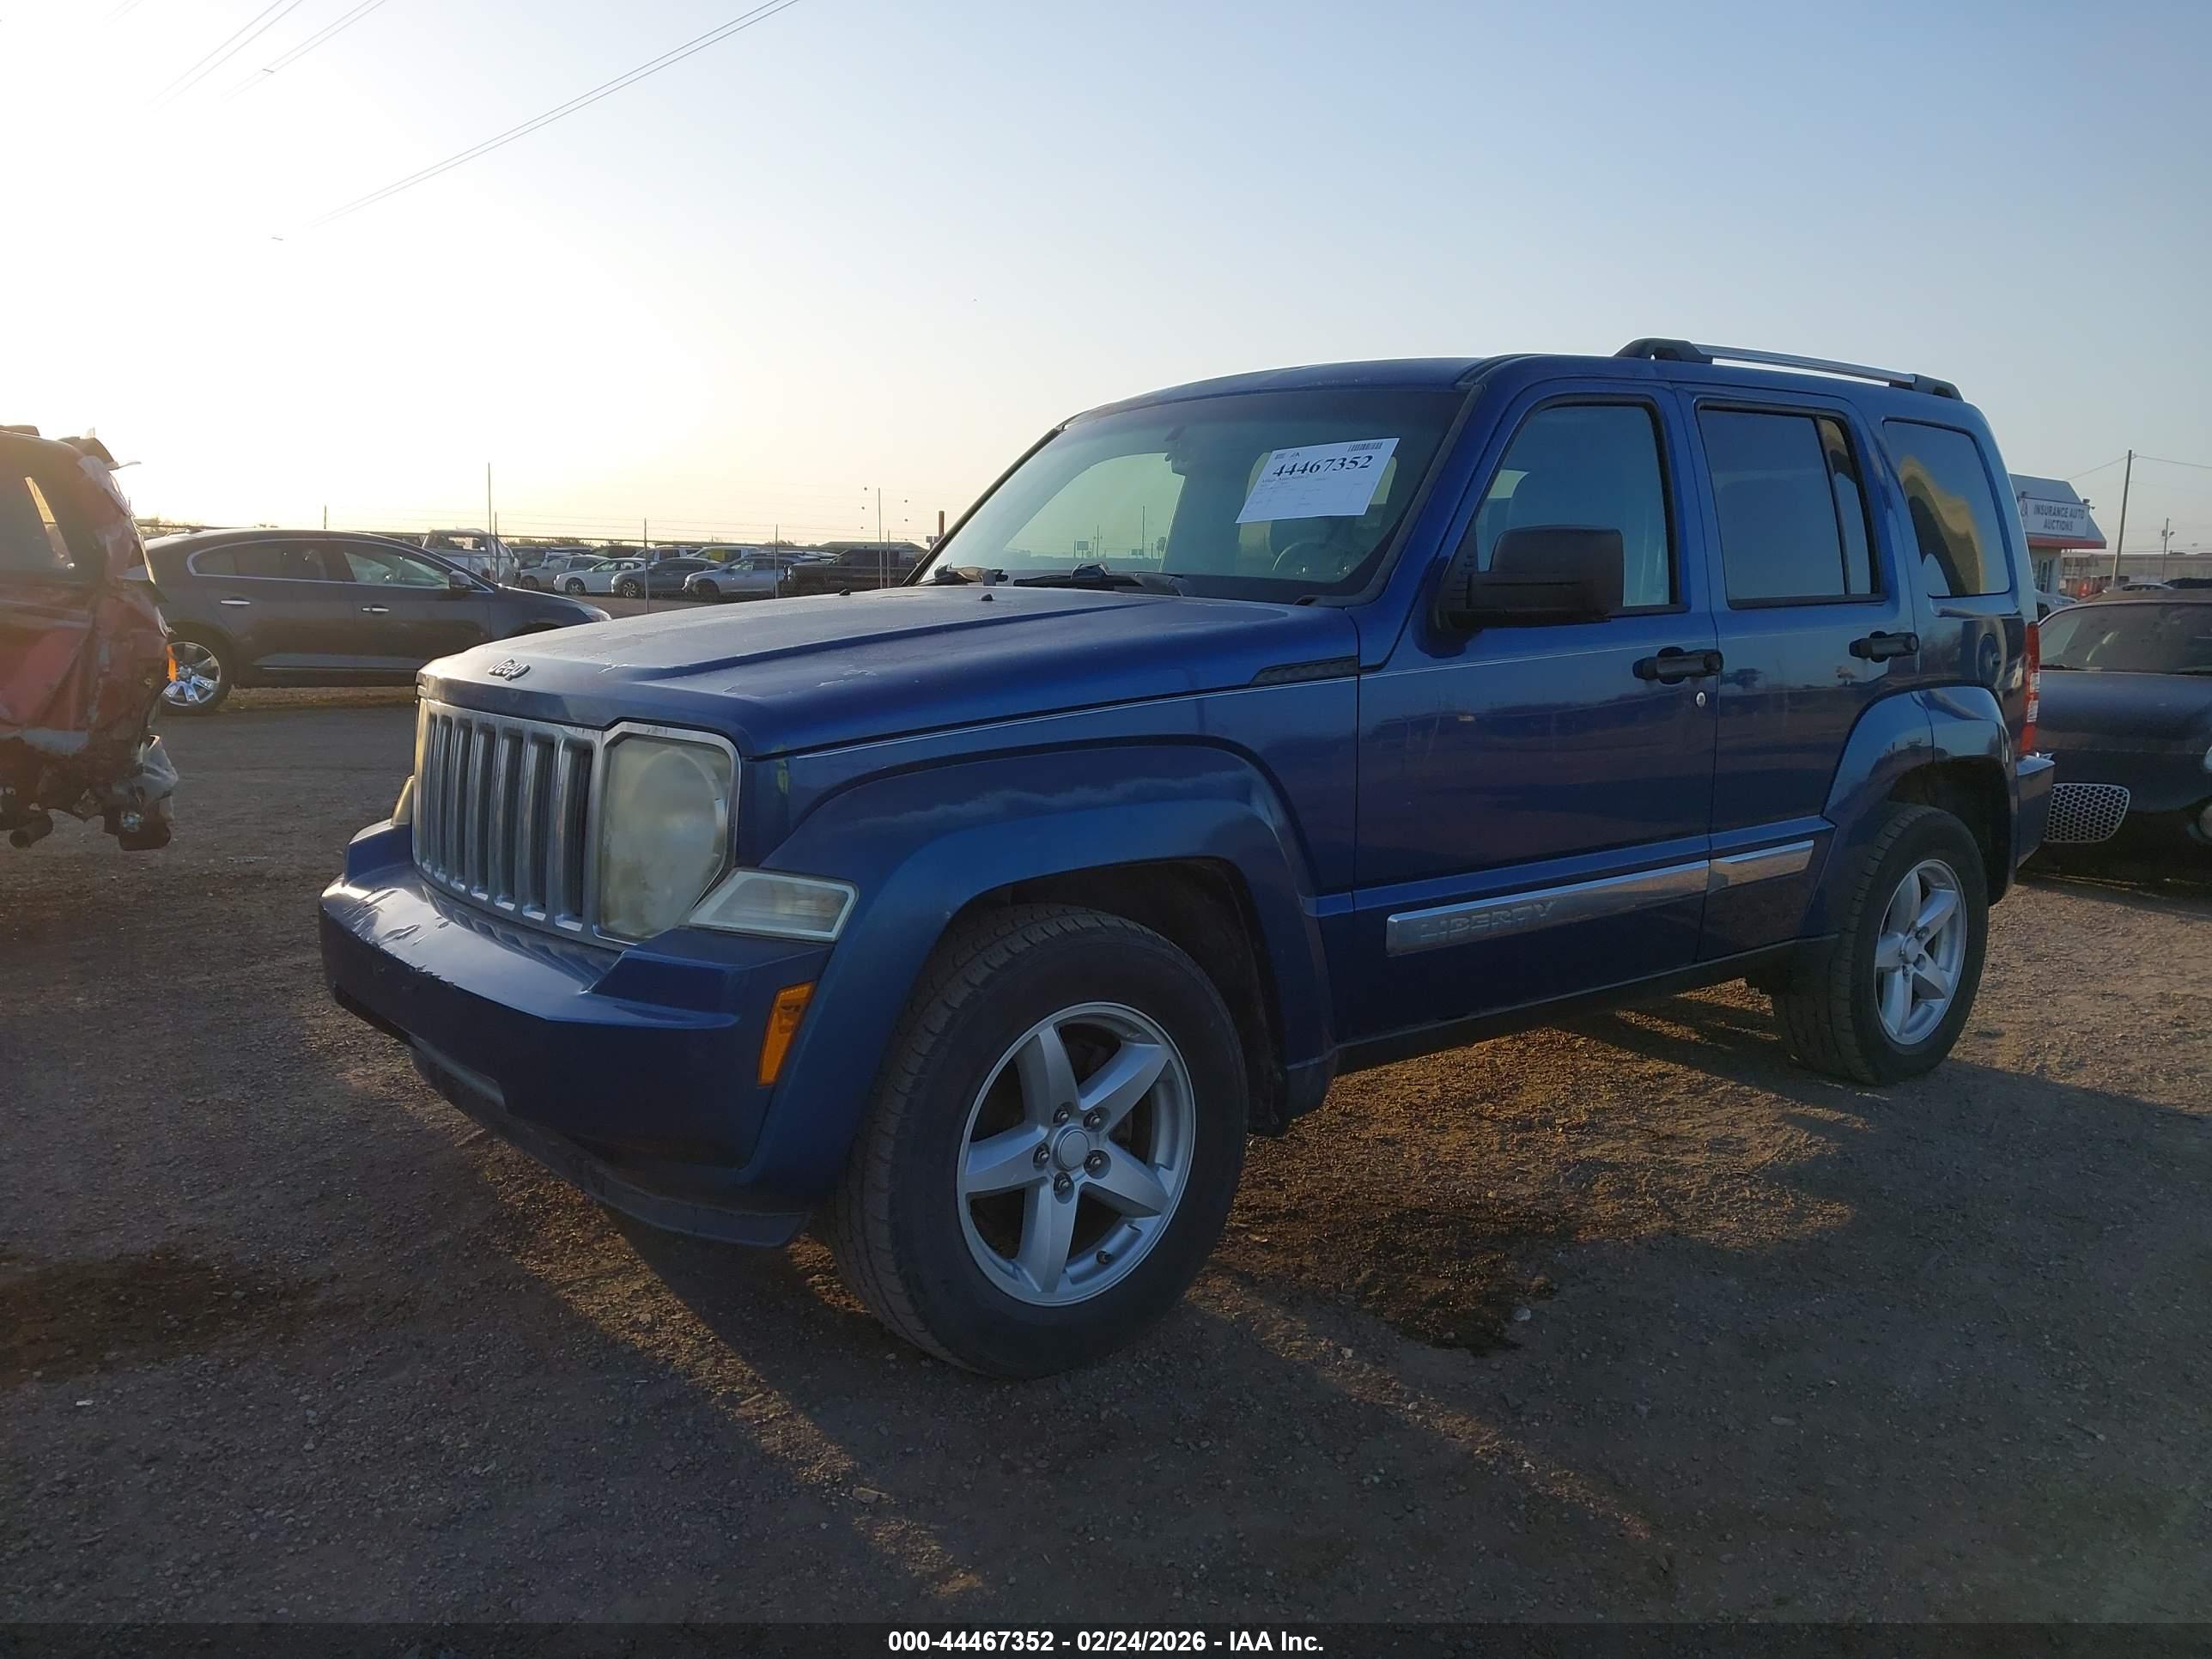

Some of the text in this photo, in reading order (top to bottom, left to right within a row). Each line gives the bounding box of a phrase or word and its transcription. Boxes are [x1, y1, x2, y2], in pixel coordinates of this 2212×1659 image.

[1273, 454, 1373, 477] 44467352
[2033, 504, 2069, 519] INSURANCE
[2069, 507, 2085, 520] AUTO
[2043, 519, 2074, 532] AUCTIONS
[487, 657, 532, 681] Jeep
[1419, 900, 1558, 939] LIBERTY
